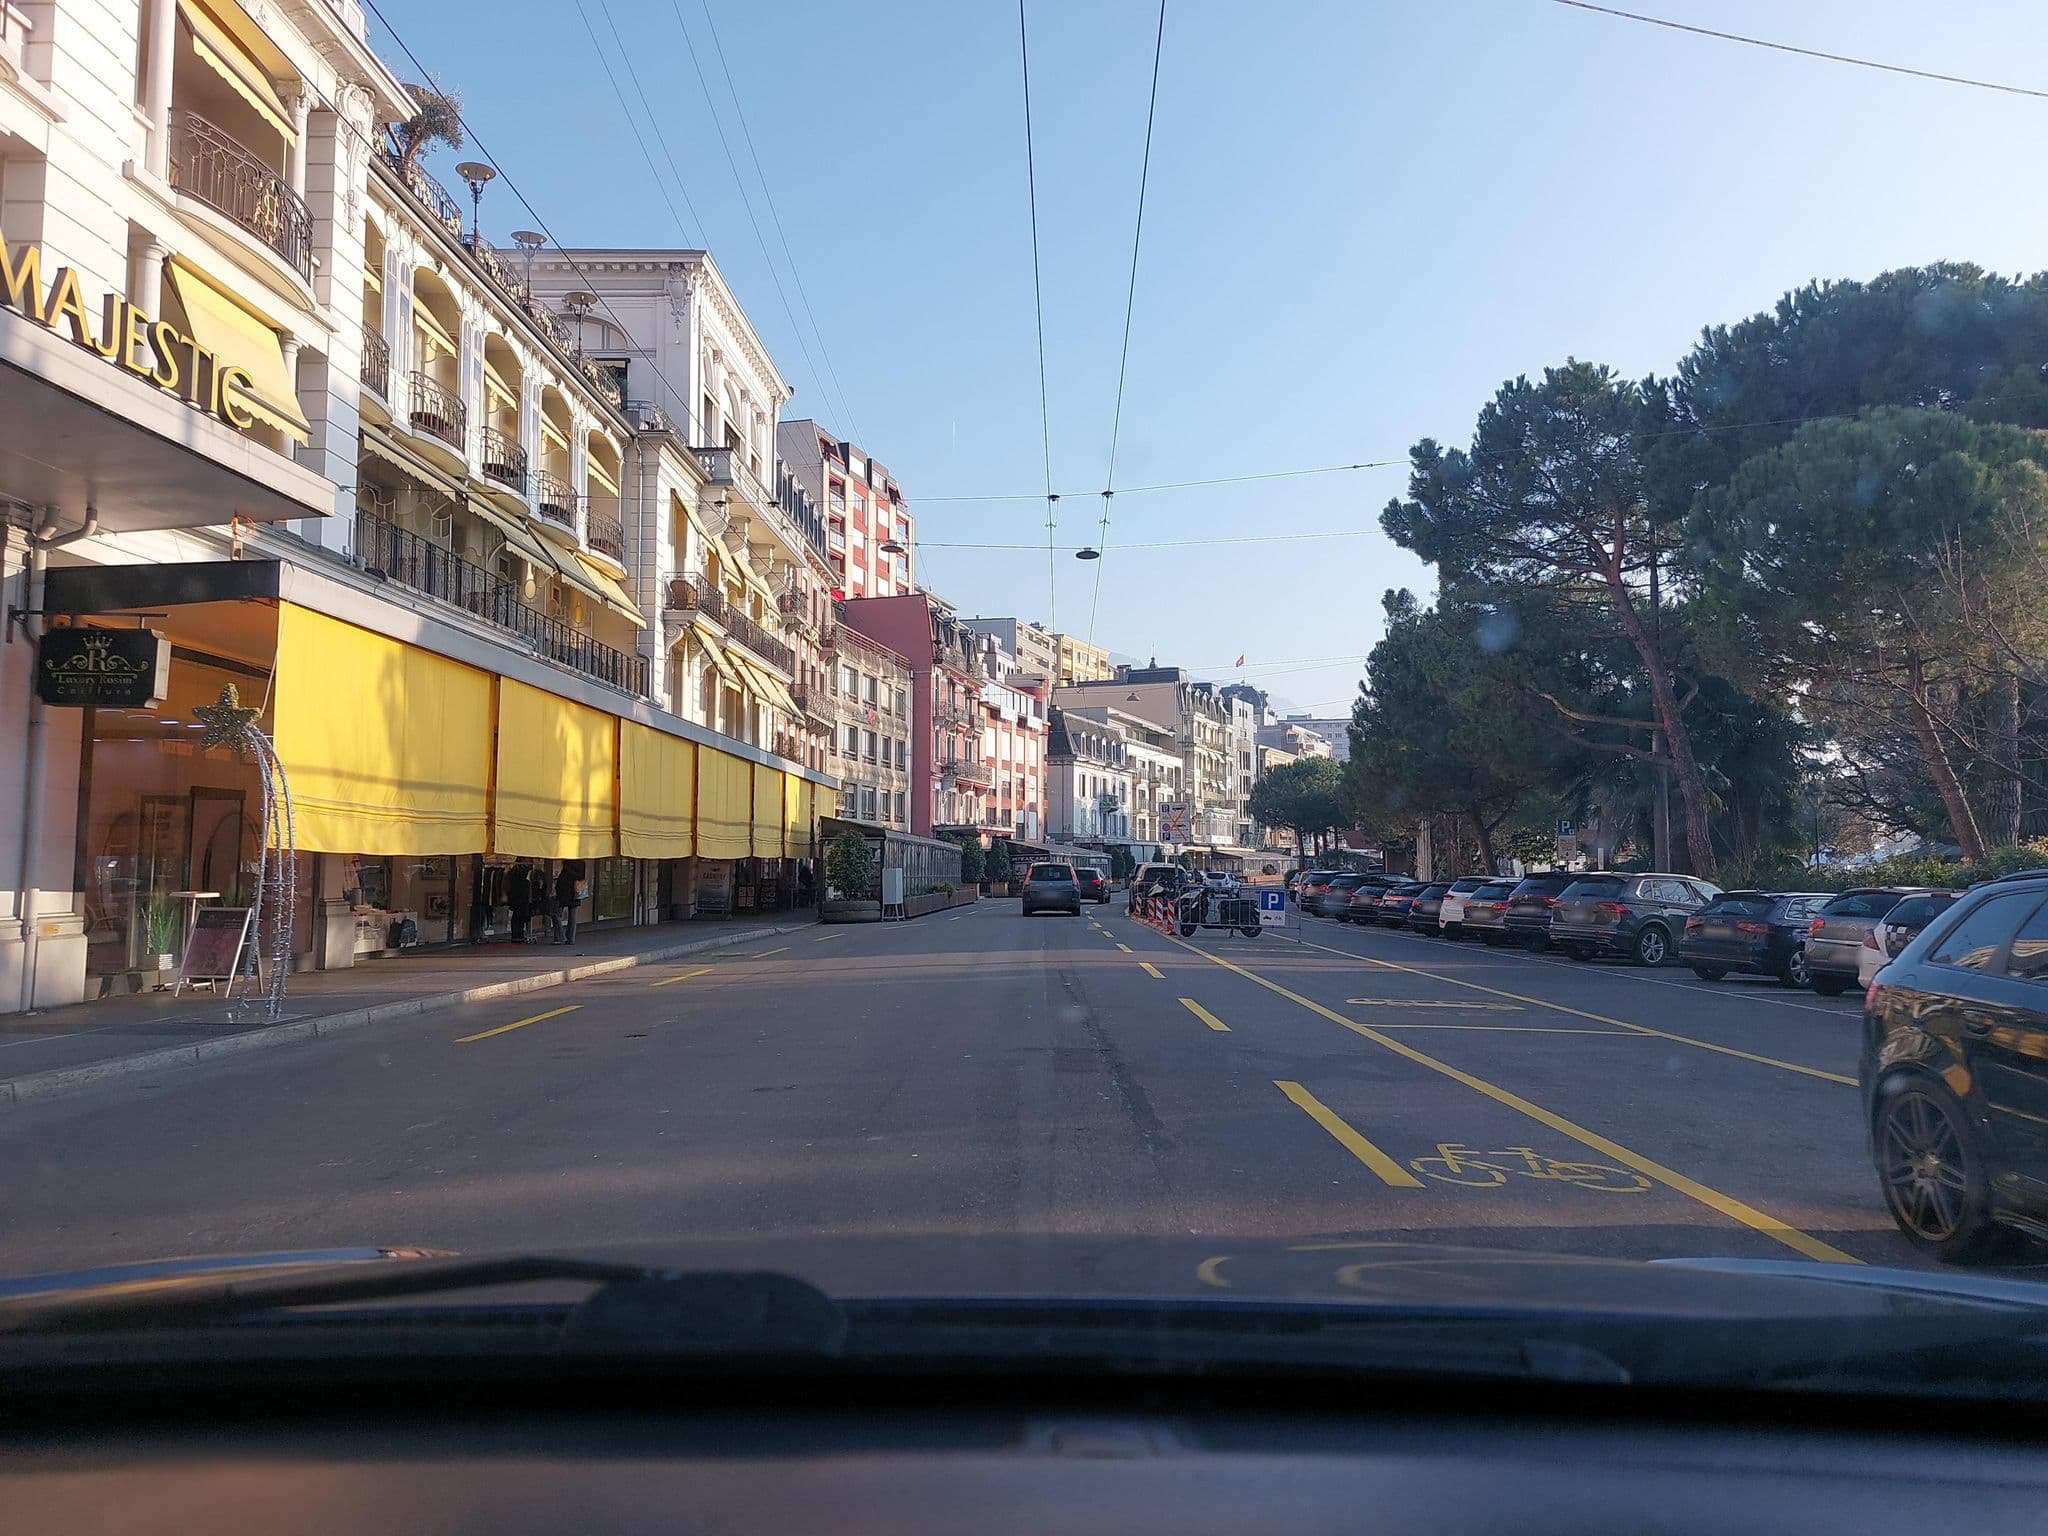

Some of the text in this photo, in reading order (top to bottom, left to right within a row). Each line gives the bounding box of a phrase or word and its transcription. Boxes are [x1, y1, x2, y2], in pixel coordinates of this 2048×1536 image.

[0, 226, 254, 429] MAJESTIC
[88, 648, 110, 671] R
[1562, 821, 1571, 832] P
[1268, 893, 1279, 909] P
